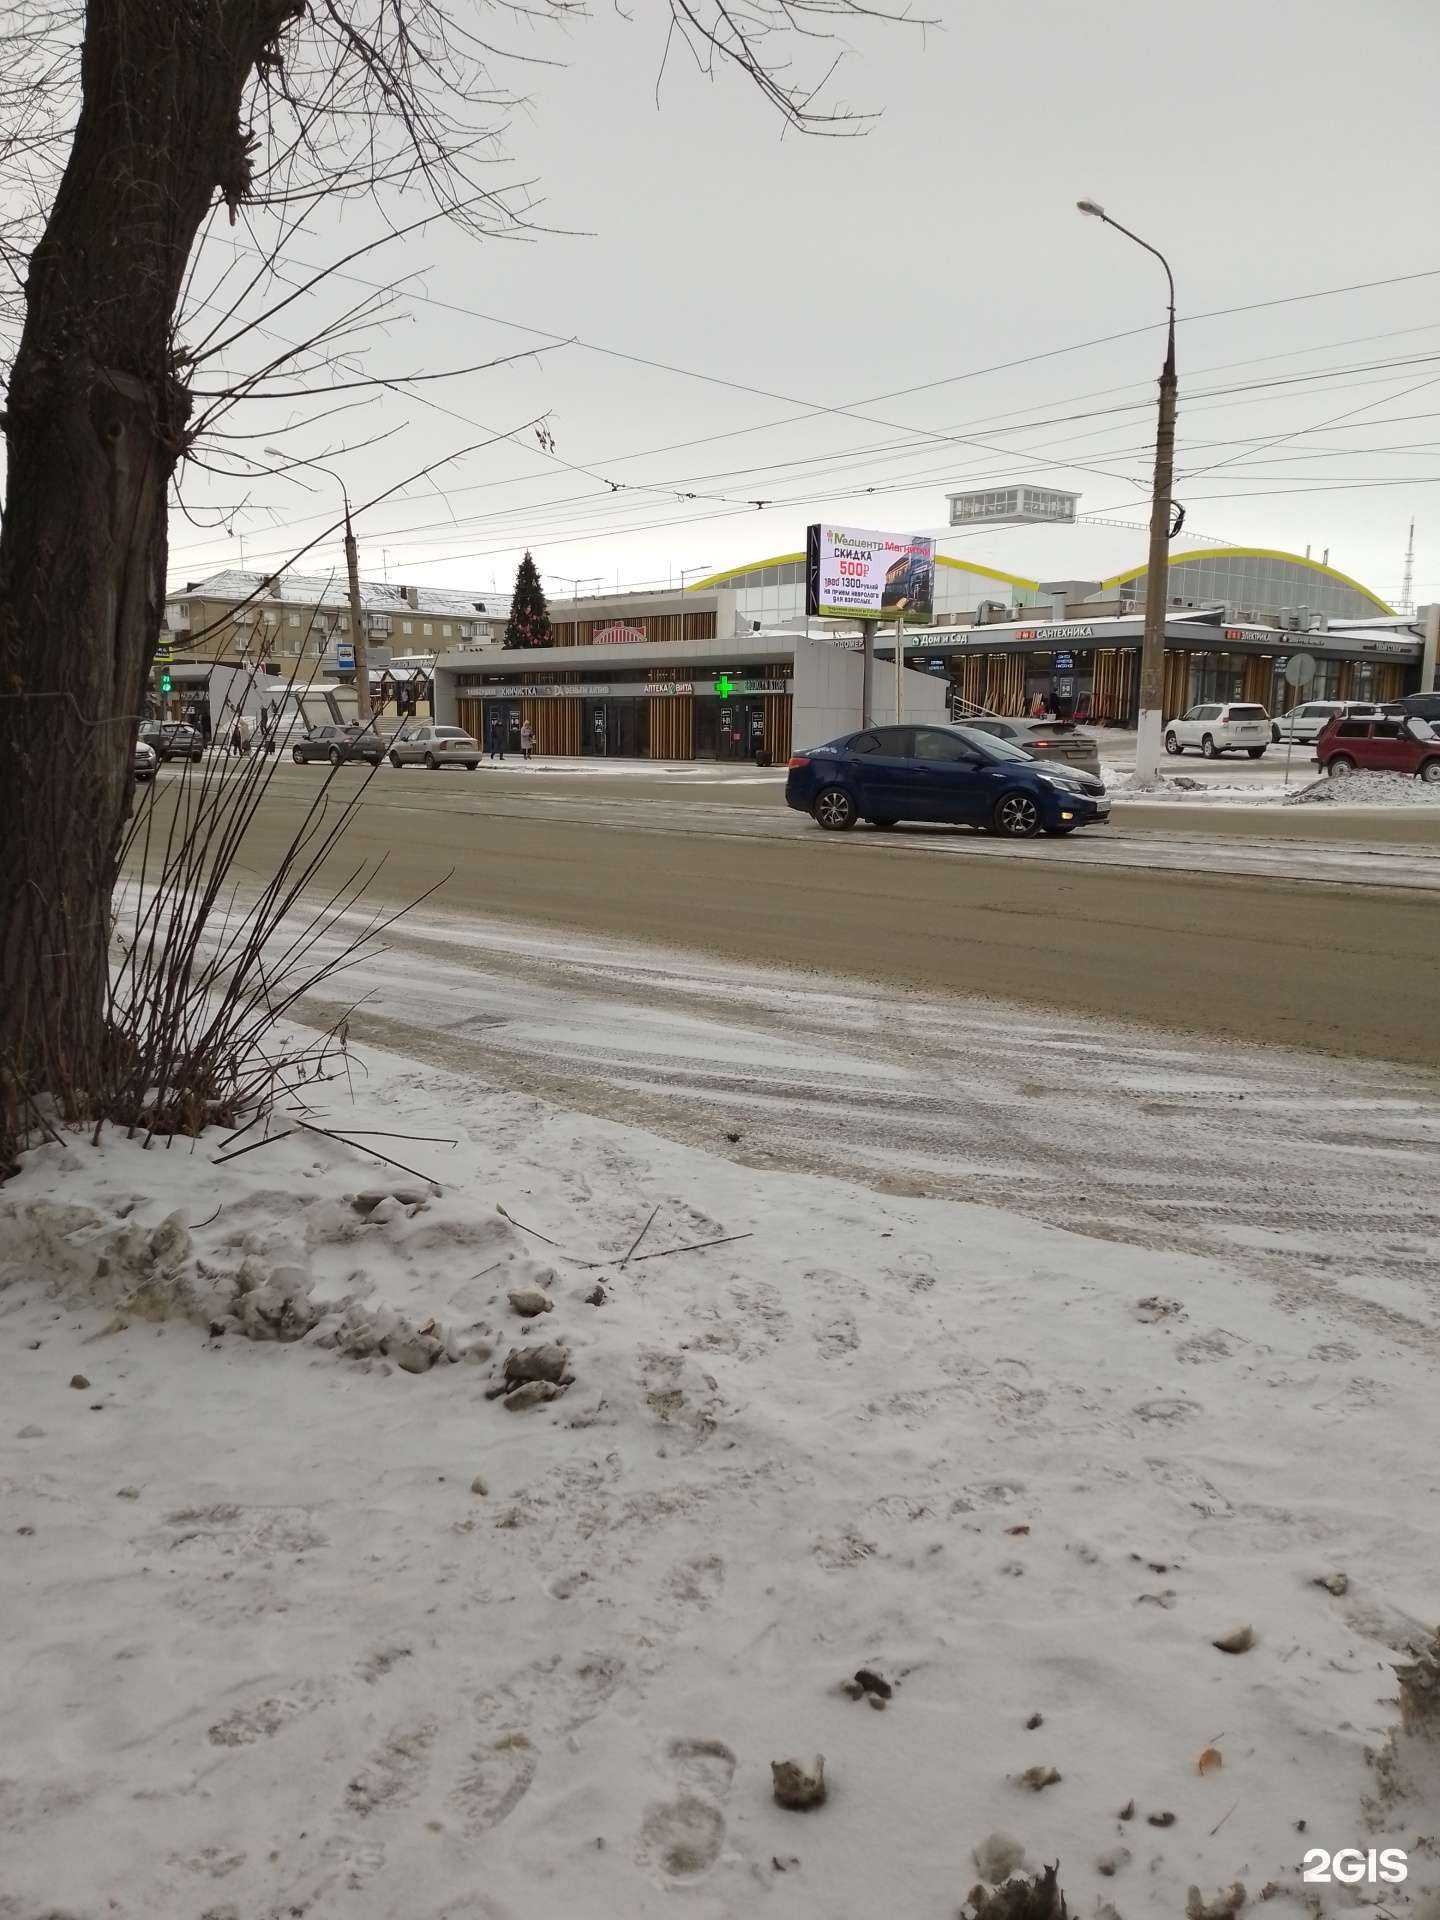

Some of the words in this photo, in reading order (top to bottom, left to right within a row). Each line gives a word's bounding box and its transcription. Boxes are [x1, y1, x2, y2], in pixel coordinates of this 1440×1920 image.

[834, 548, 872, 561] СКИДКА
[842, 578, 861, 588] 1300
[921, 634, 940, 646] Дом
[951, 632, 968, 644] Сад
[1037, 626, 1092, 639] САНТЕХНИКА
[644, 684, 668, 693] АПТЕКА
[676, 683, 692, 692] ВИТА
